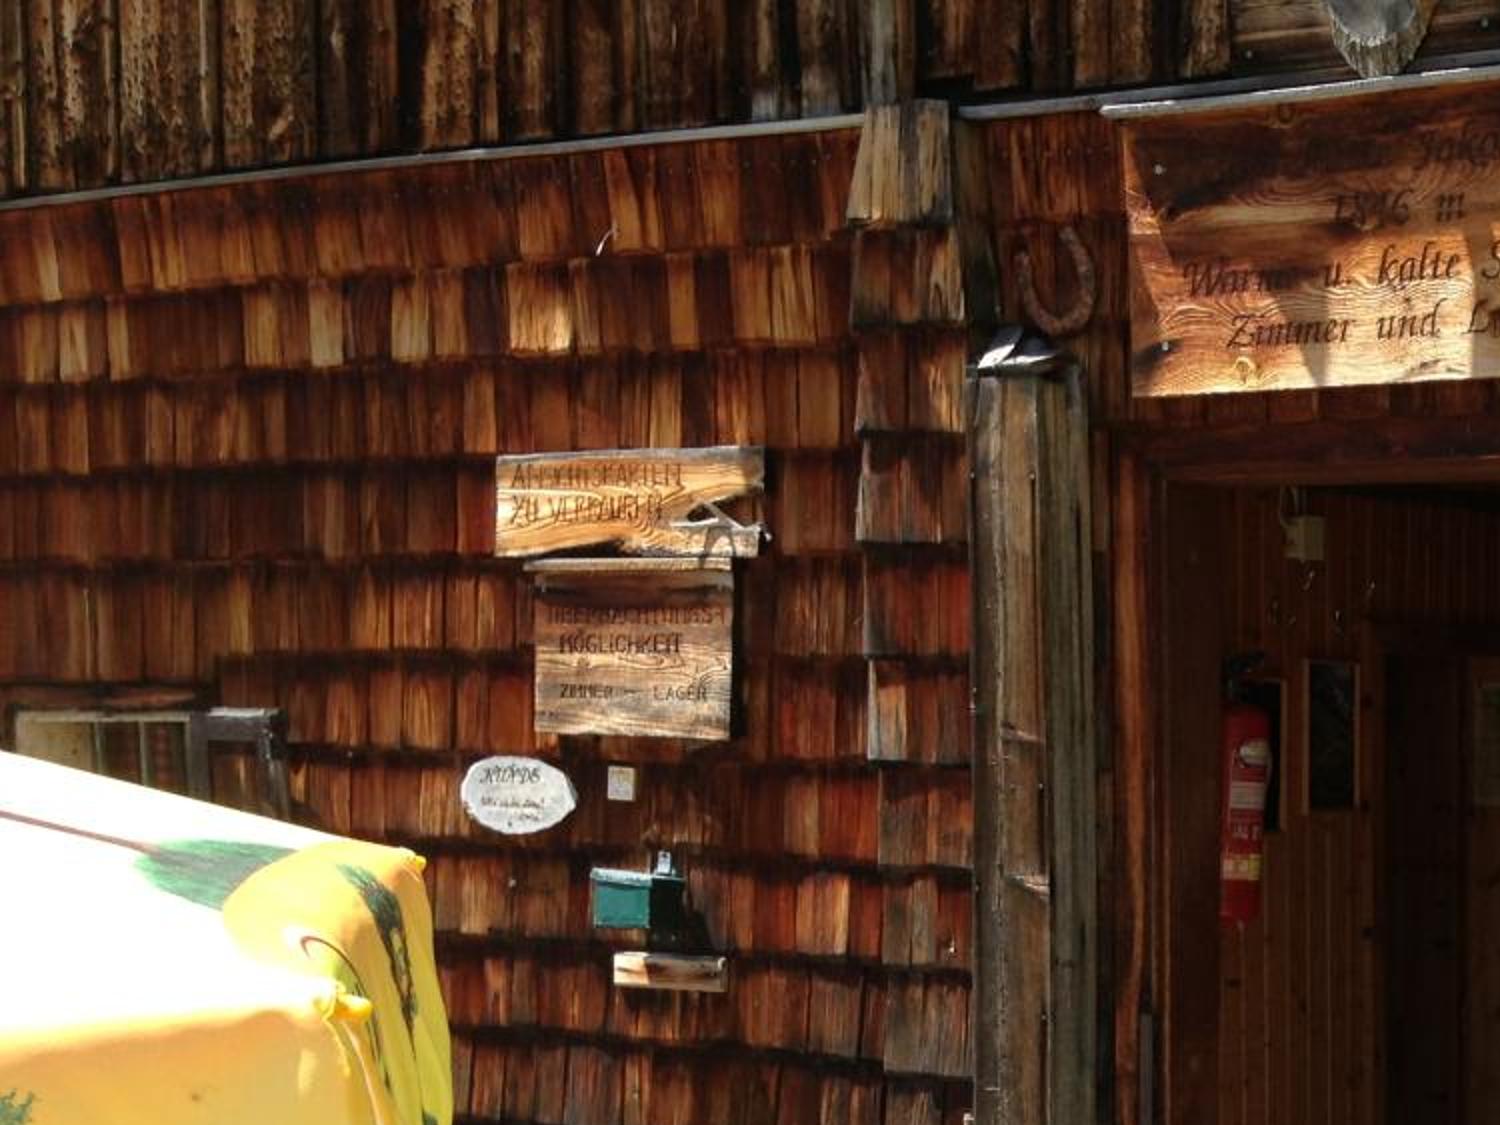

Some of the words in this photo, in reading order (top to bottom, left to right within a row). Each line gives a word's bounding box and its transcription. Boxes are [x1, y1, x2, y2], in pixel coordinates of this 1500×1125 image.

[1378, 242, 1462, 292] kalte
[1226, 312, 1356, 350] Zimmer
[1376, 298, 1442, 340] und
[559, 683, 613, 699] ZIMMER
[653, 684, 708, 702] LAGER
